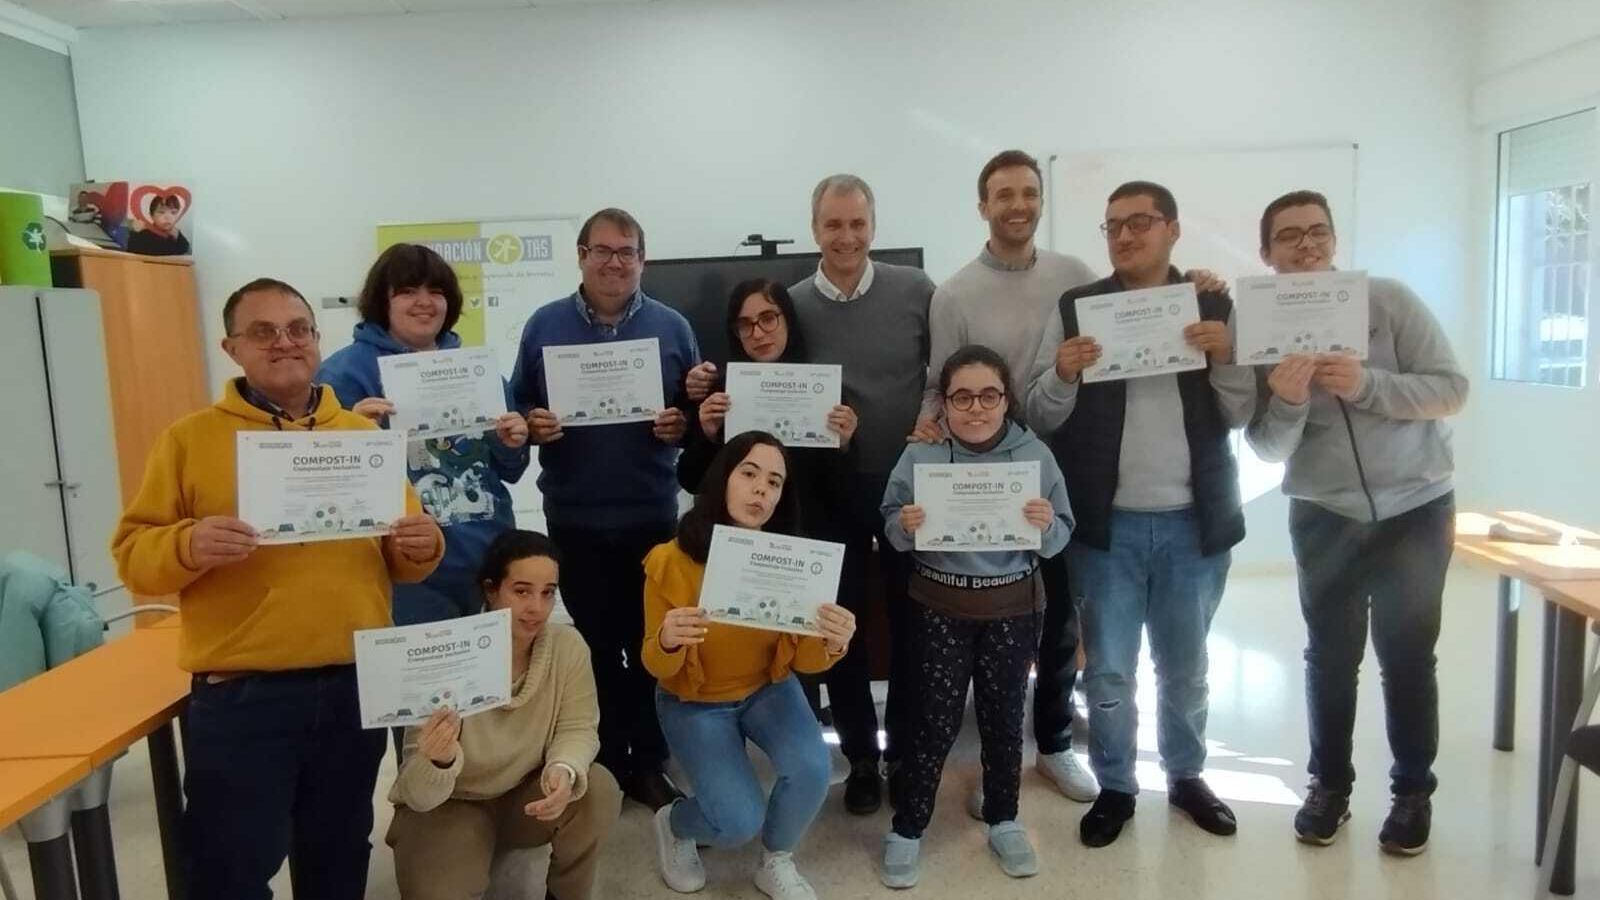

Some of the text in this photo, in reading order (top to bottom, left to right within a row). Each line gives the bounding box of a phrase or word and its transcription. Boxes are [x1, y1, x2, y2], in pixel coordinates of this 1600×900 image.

[431, 239, 482, 261] DACIÓN
[293, 455, 361, 466] COMPOST-IN
[953, 482, 1005, 491] COMPOST-IN
[751, 552, 805, 567] COMPOST-IN
[407, 640, 471, 657] COMPOST-IN
